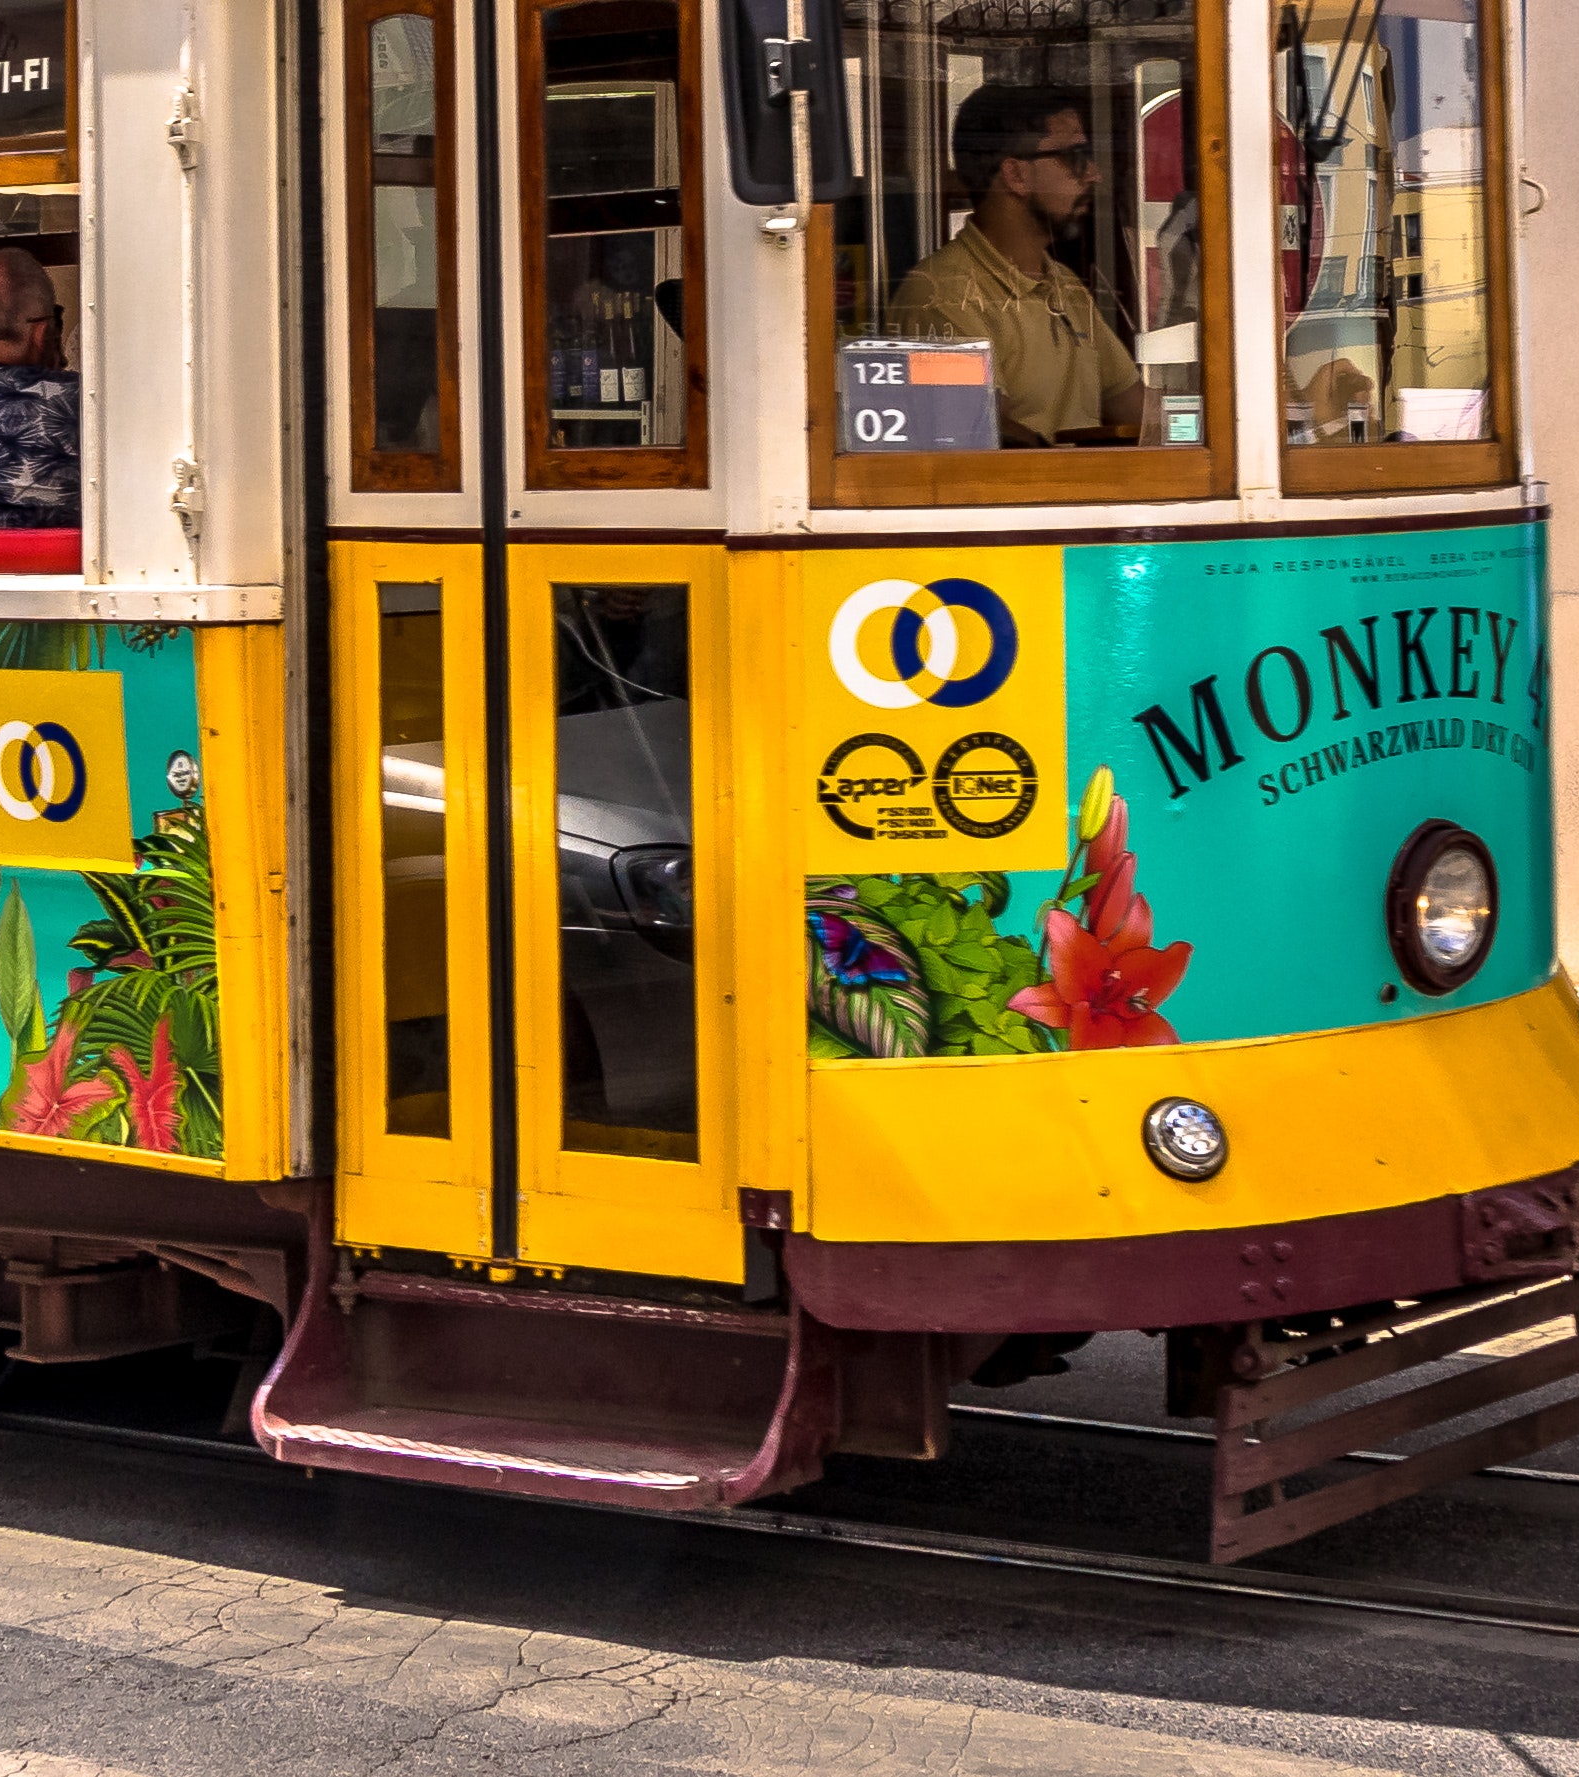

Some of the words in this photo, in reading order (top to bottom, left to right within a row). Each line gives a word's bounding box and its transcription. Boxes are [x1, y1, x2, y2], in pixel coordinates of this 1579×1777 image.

[853, 362, 905, 385] 12E
[855, 408, 908, 442] 02
[1204, 562, 1260, 576] SEJA
[1133, 606, 1518, 800] MONKEY
[1257, 717, 1466, 807] SCHWARZWALD
[1471, 719, 1510, 757] DRY
